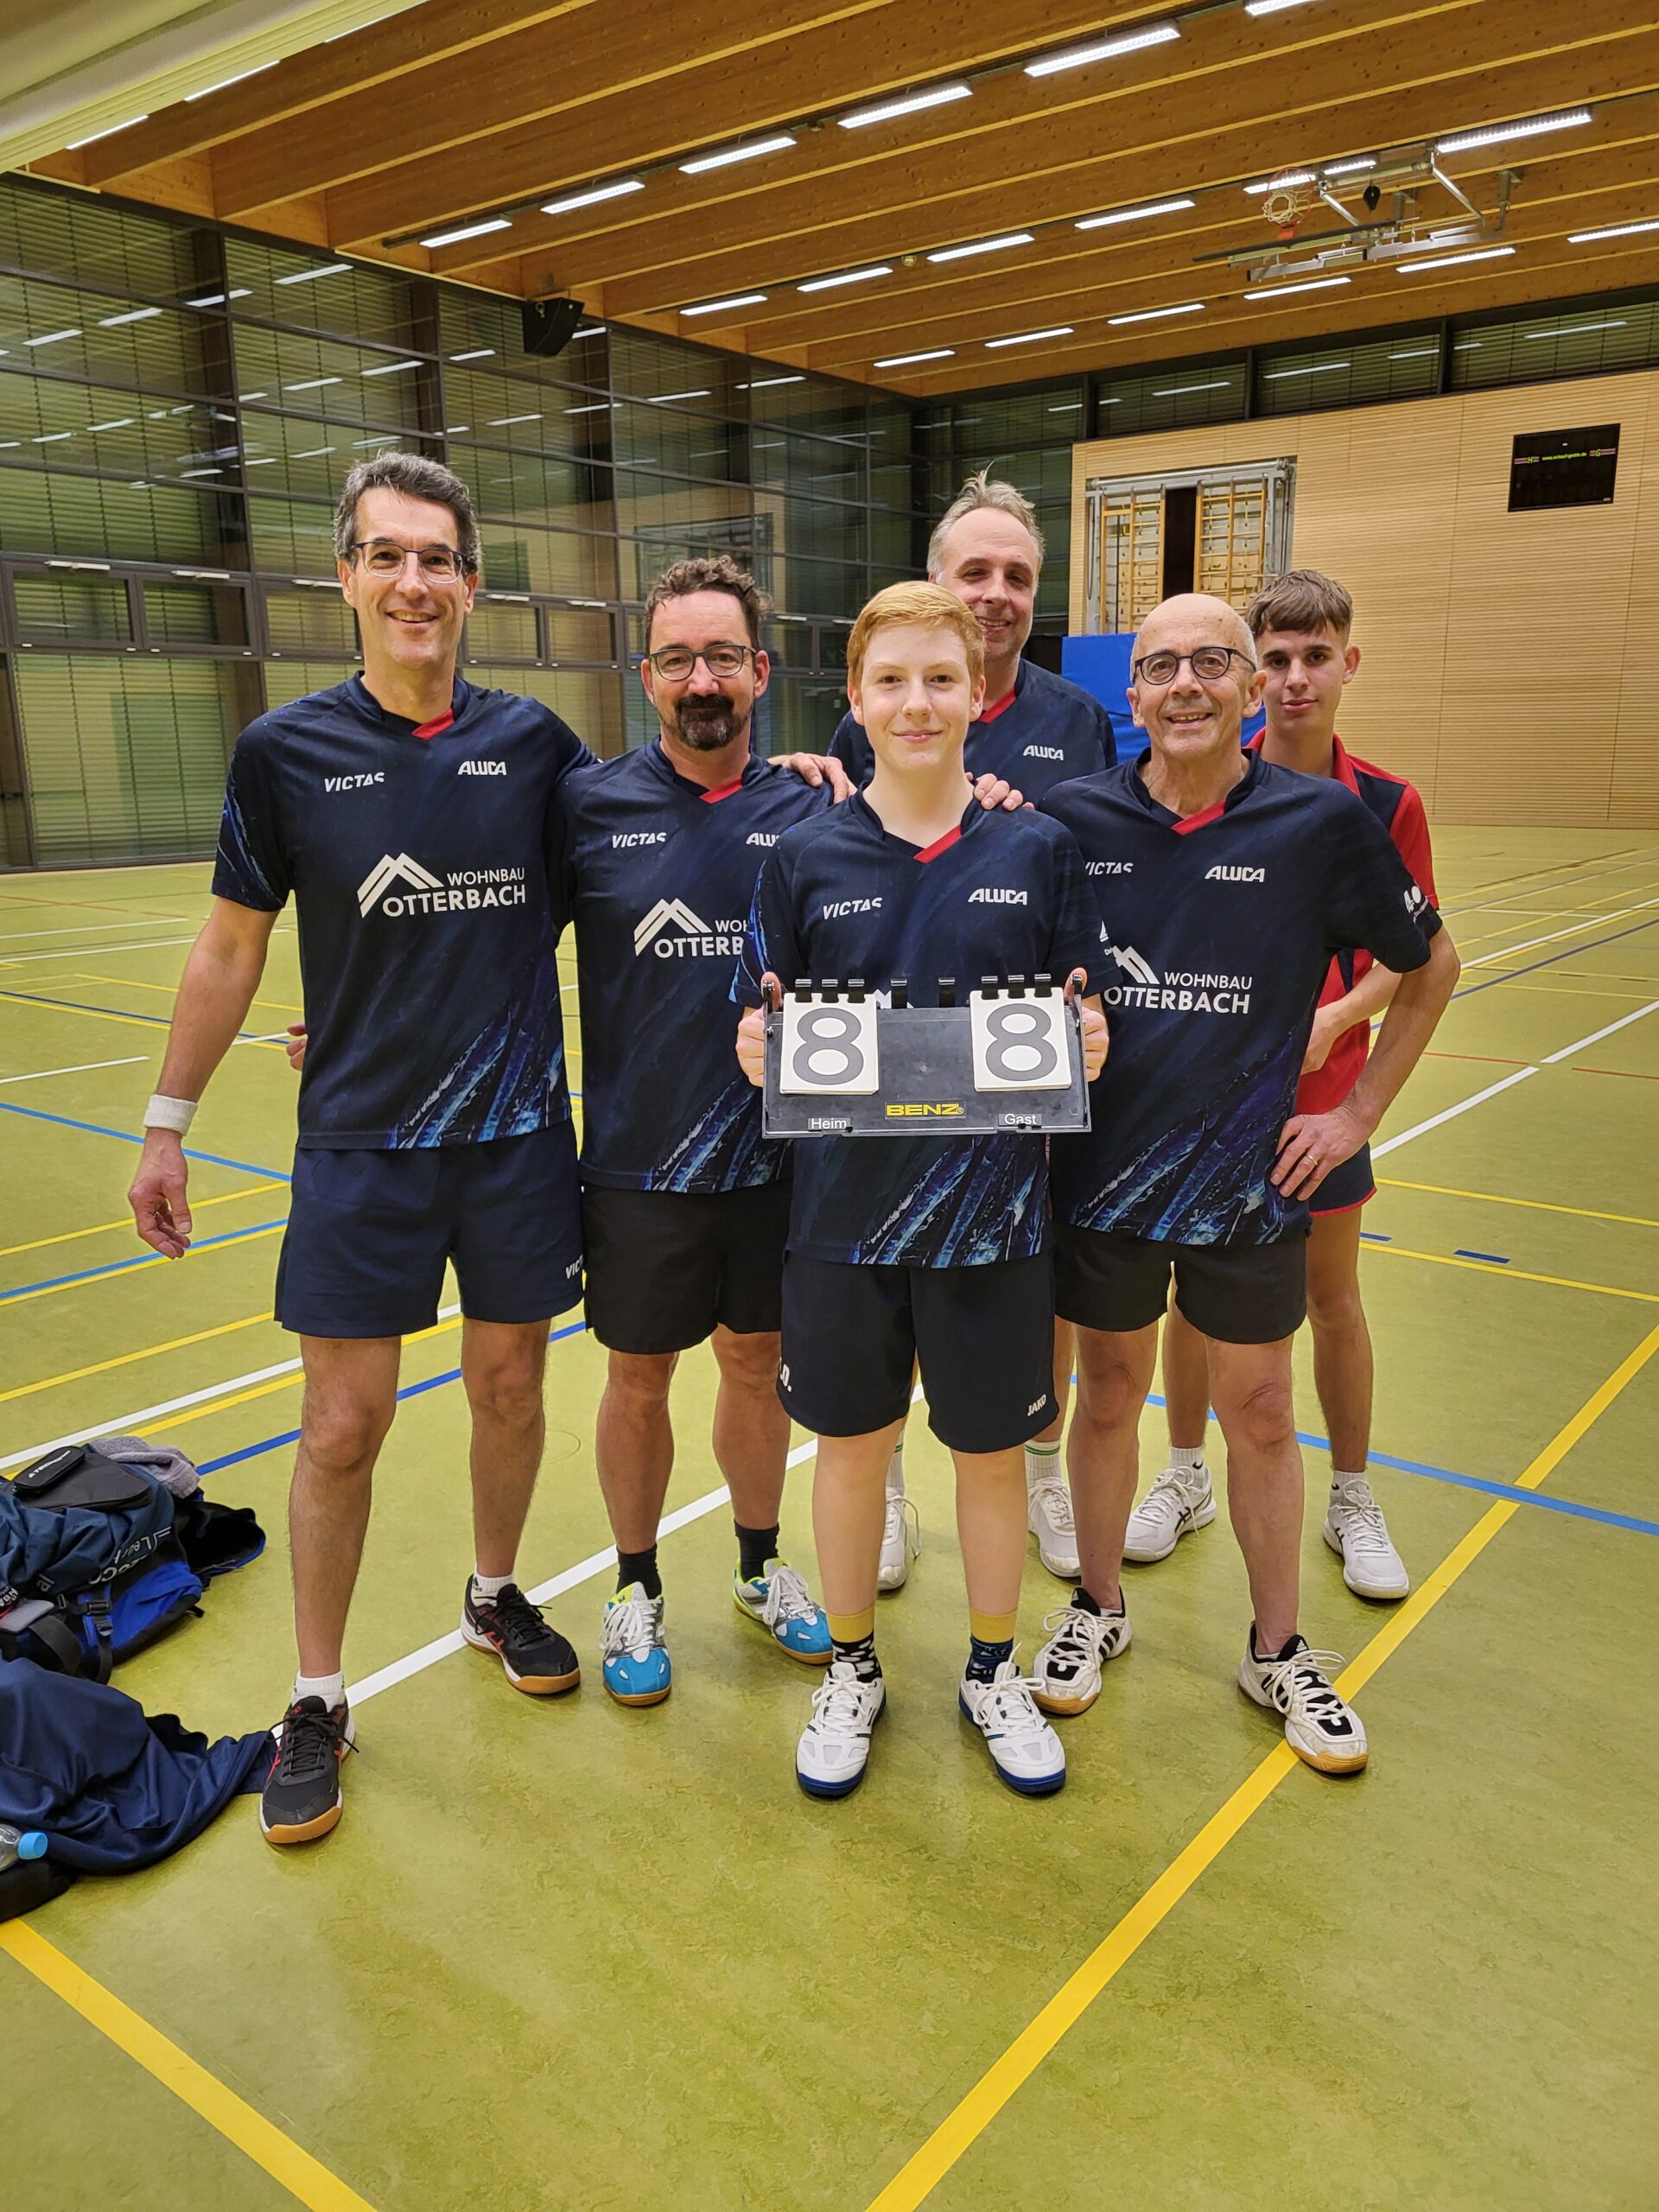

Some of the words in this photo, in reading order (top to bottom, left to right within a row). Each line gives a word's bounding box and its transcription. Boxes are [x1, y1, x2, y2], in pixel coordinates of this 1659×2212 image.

[1022, 745, 1065, 761] ALUCA
[458, 760, 507, 776] ALUCA
[324, 772, 385, 793] VICTAS
[612, 832, 667, 849] VICTAS
[746, 832, 780, 848] ALU
[447, 867, 525, 887] WOHNBAU
[1204, 865, 1266, 883] ALUCA
[382, 884, 526, 918] OTTERBACH
[967, 887, 1028, 906] ALUCA
[823, 897, 883, 920] VICTAS
[654, 936, 744, 958] OTTERB
[1164, 971, 1253, 990] WOHNBAU
[1103, 986, 1250, 1014] OTTERBACH
[792, 1007, 864, 1085] 8
[985, 1002, 1058, 1082] 8
[810, 1118, 848, 1130] Heim
[1004, 1114, 1037, 1125] Gast
[1027, 1394, 1047, 1417] JAKO
